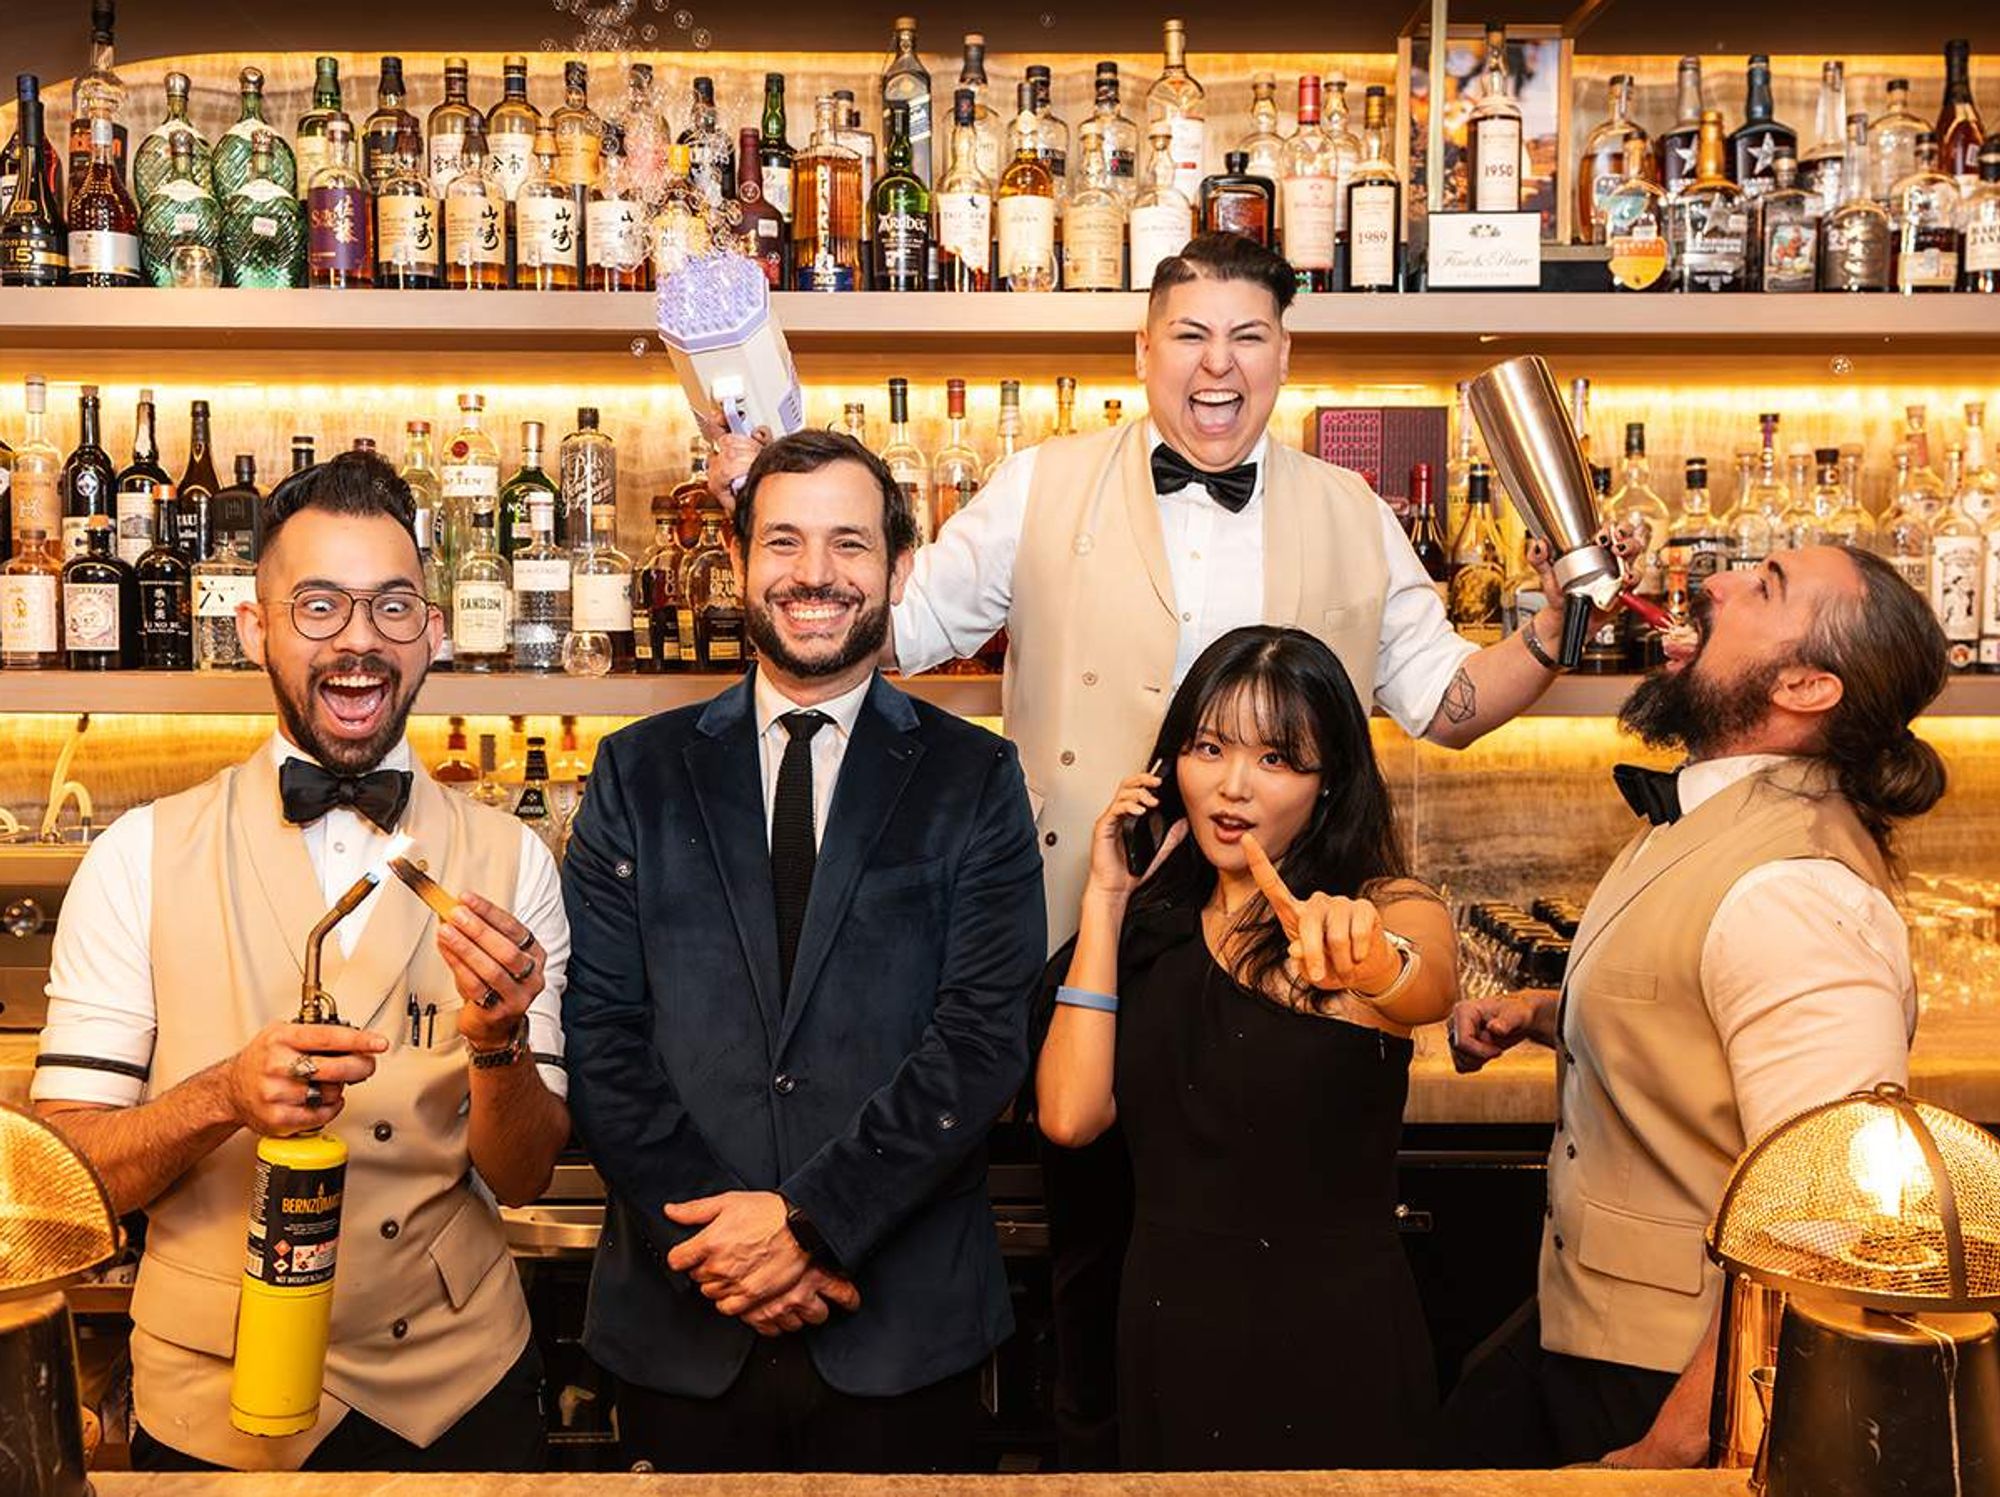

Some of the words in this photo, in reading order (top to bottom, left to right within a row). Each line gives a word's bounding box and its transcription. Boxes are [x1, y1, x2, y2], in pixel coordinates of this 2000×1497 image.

[1358, 231, 1388, 244] 1989
[8, 248, 33, 263] 15
[460, 598, 501, 611] RANSOM
